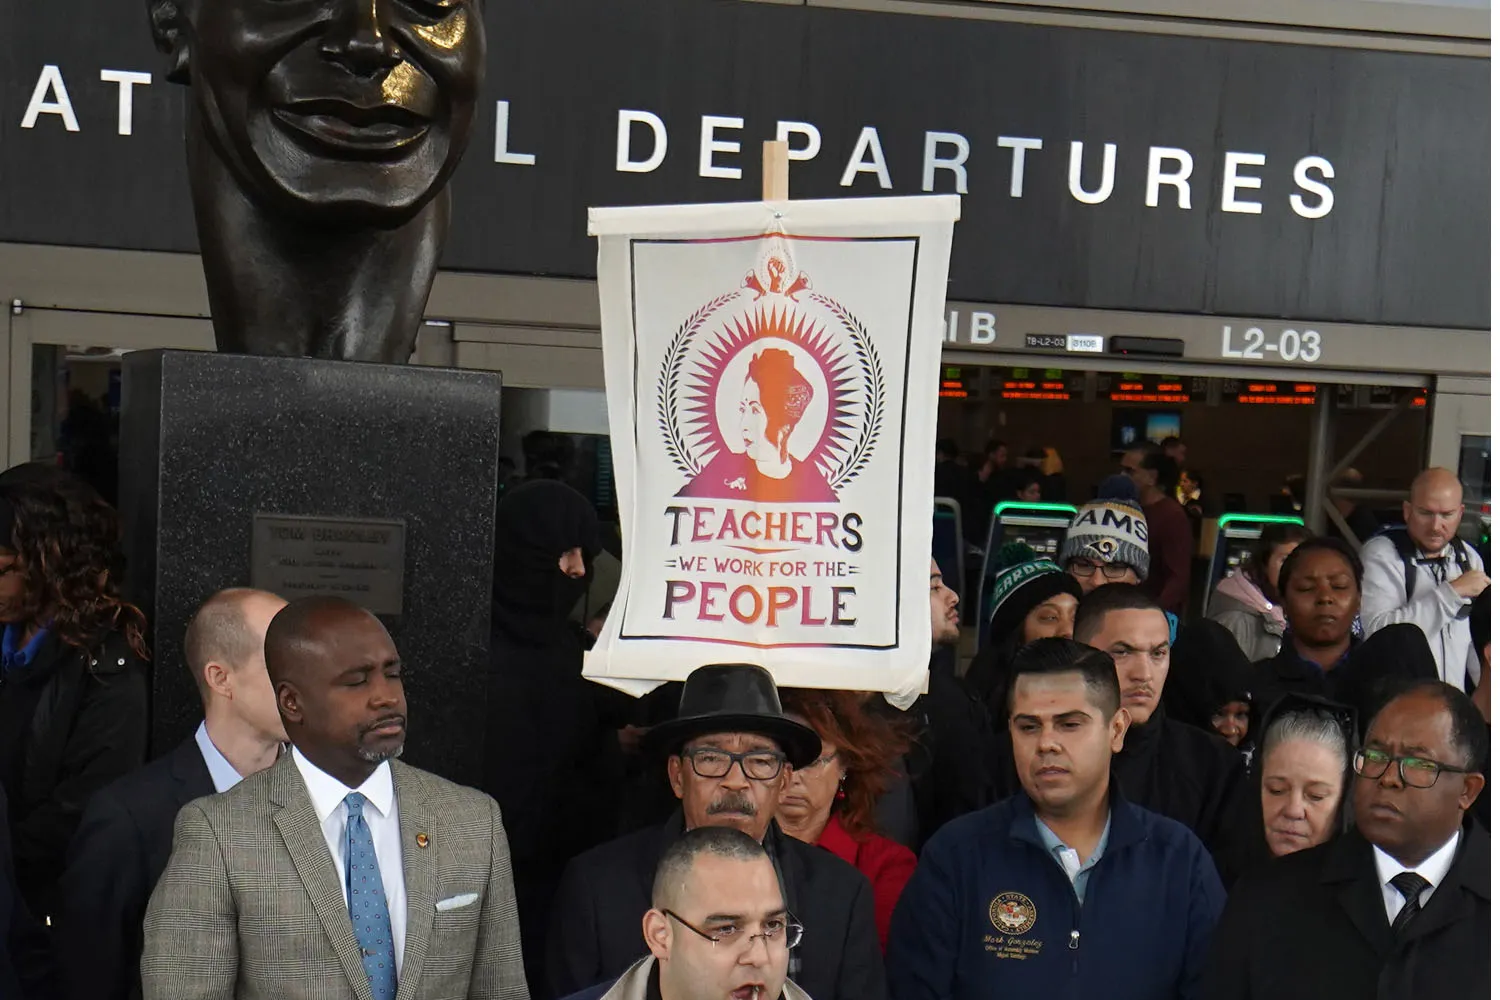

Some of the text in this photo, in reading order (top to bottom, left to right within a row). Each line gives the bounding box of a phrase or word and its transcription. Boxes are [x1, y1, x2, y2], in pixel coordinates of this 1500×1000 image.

[616, 110, 1335, 219] DEPARTURES
[1221, 326, 1321, 363] L2-03
[664, 505, 863, 553] TEACHERS
[1069, 508, 1148, 542] AMS
[679, 556, 847, 577] WE WORK FOR THE
[662, 580, 857, 628] PEOPLE
